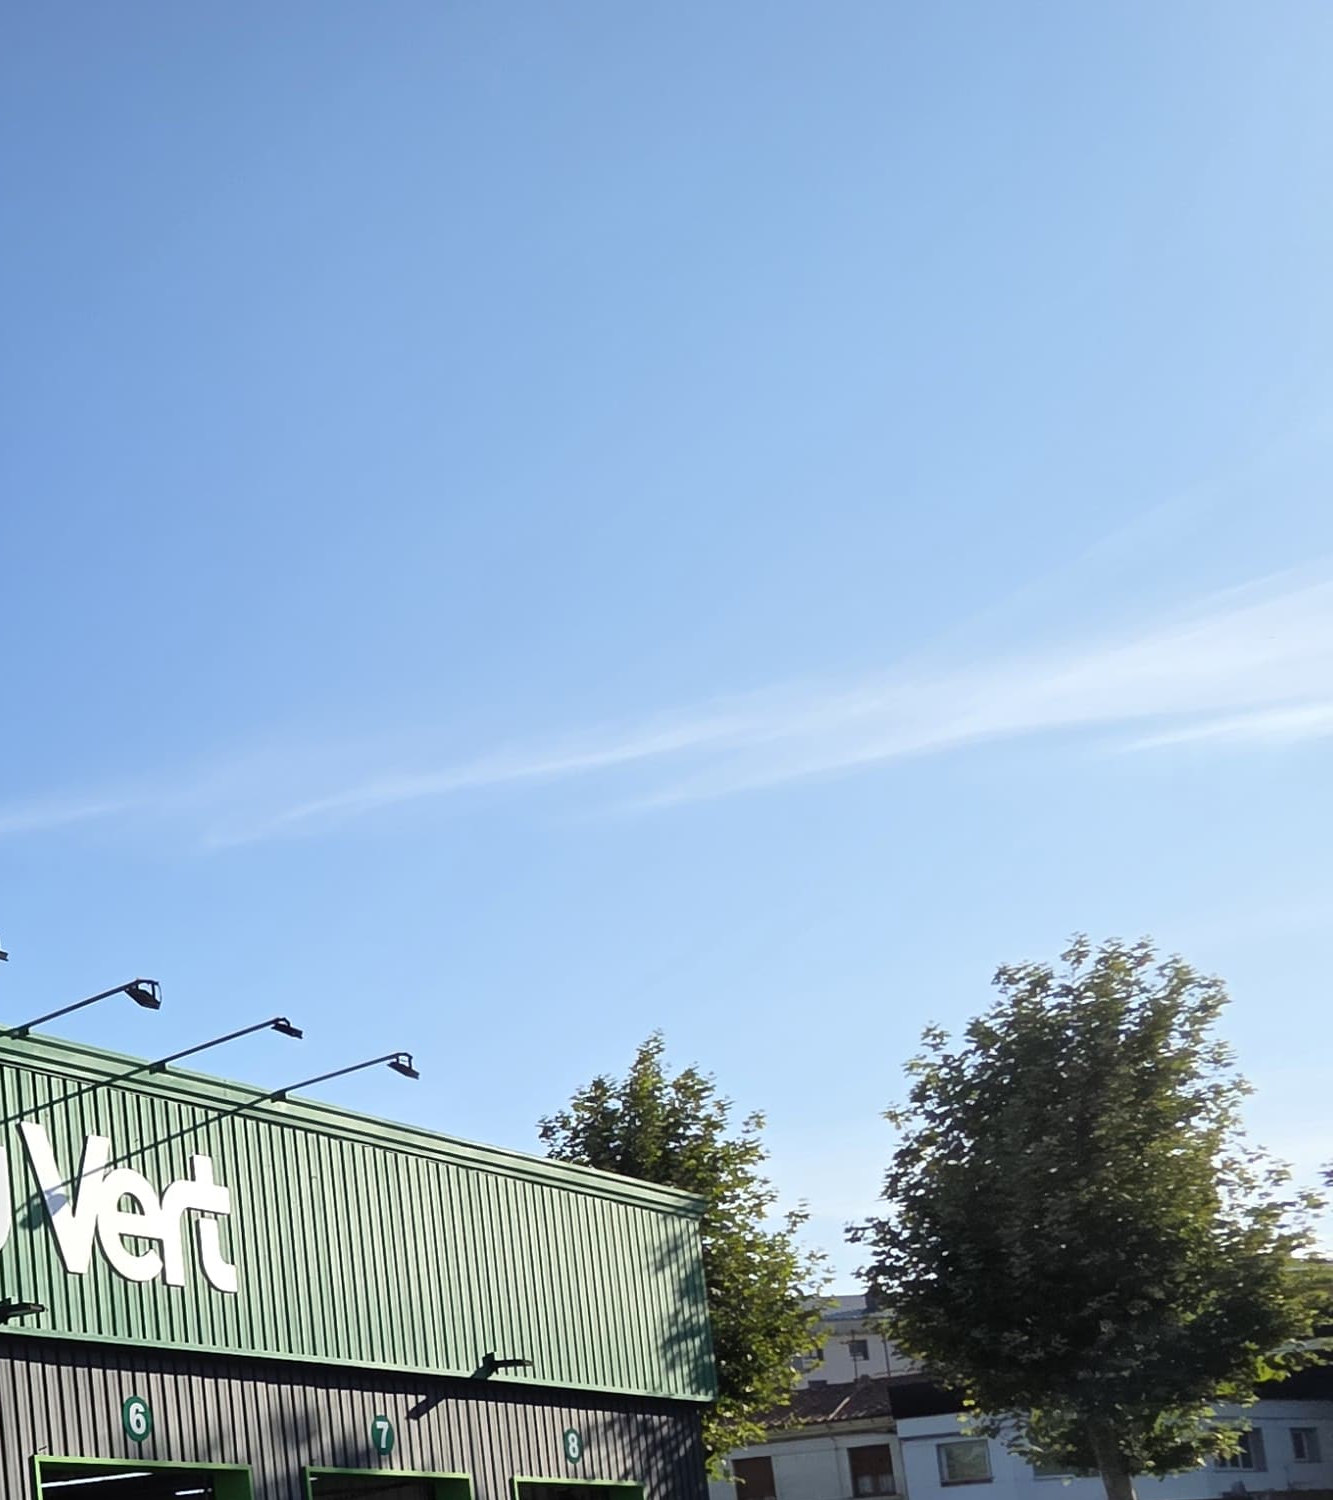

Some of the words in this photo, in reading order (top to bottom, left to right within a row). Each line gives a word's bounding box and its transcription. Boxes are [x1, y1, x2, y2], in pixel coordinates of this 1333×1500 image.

[20, 1120, 239, 1293] Vert
[129, 1402, 147, 1434] 6
[375, 1421, 389, 1449] 7
[567, 1433, 580, 1459] 8
